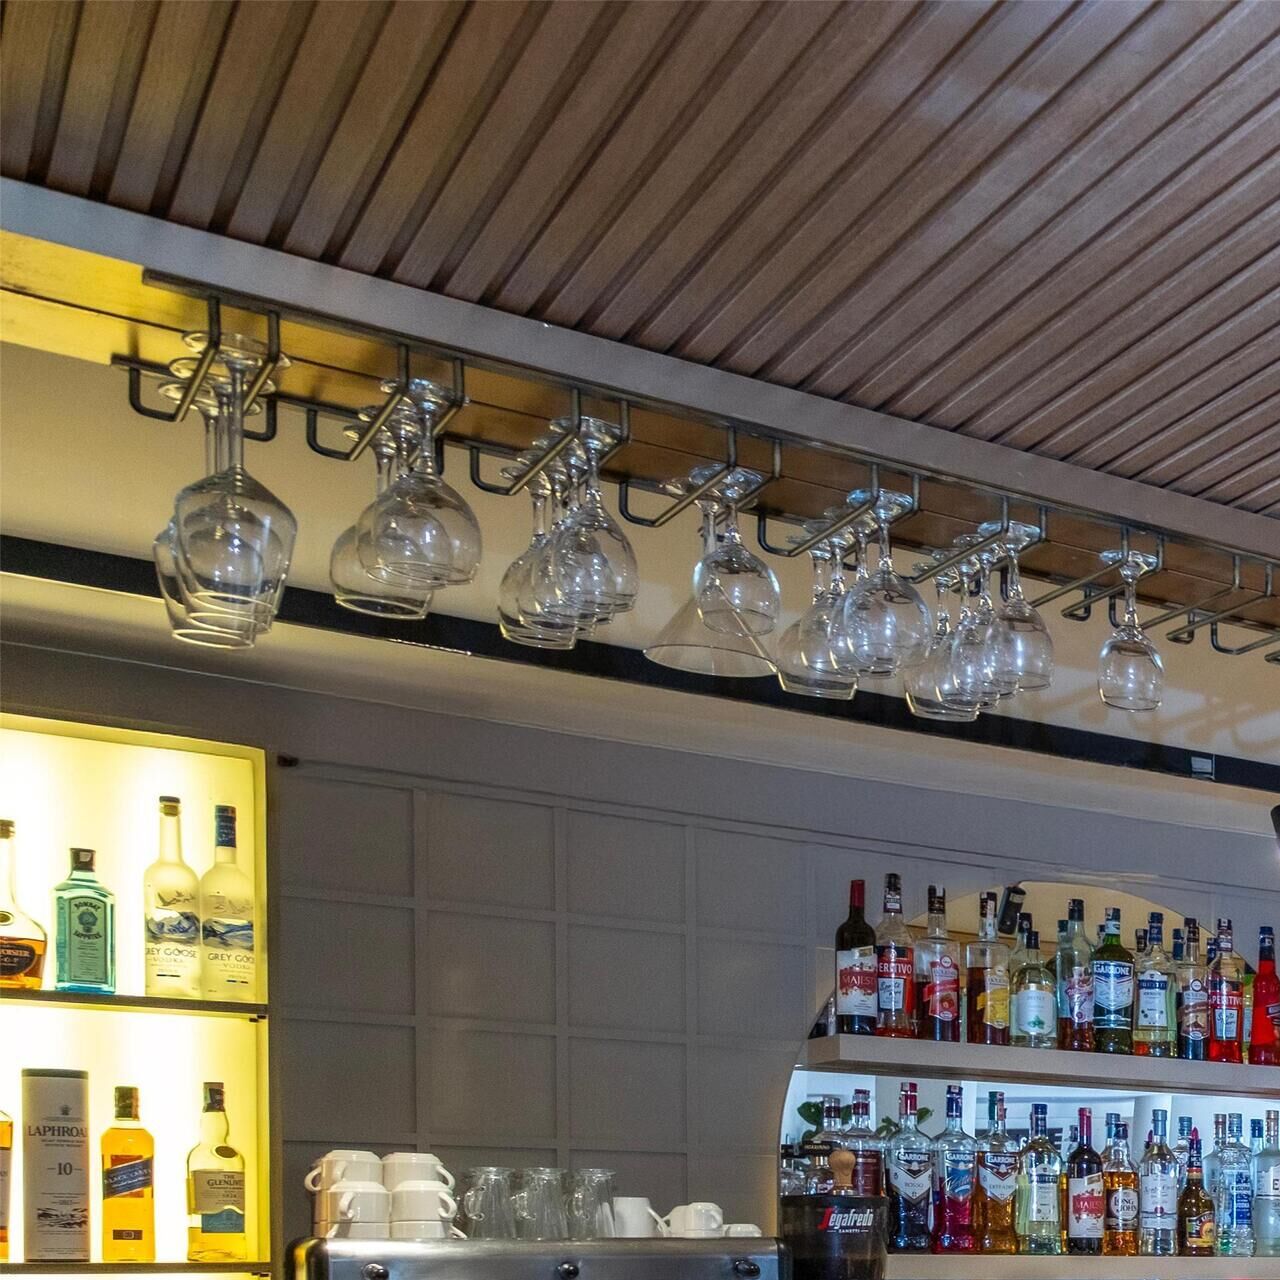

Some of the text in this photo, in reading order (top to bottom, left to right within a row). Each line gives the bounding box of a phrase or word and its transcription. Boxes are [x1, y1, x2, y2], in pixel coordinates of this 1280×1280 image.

[164, 947, 197, 958] GOOSE
[208, 952, 231, 960] GREY
[57, 1162, 73, 1175] 10
